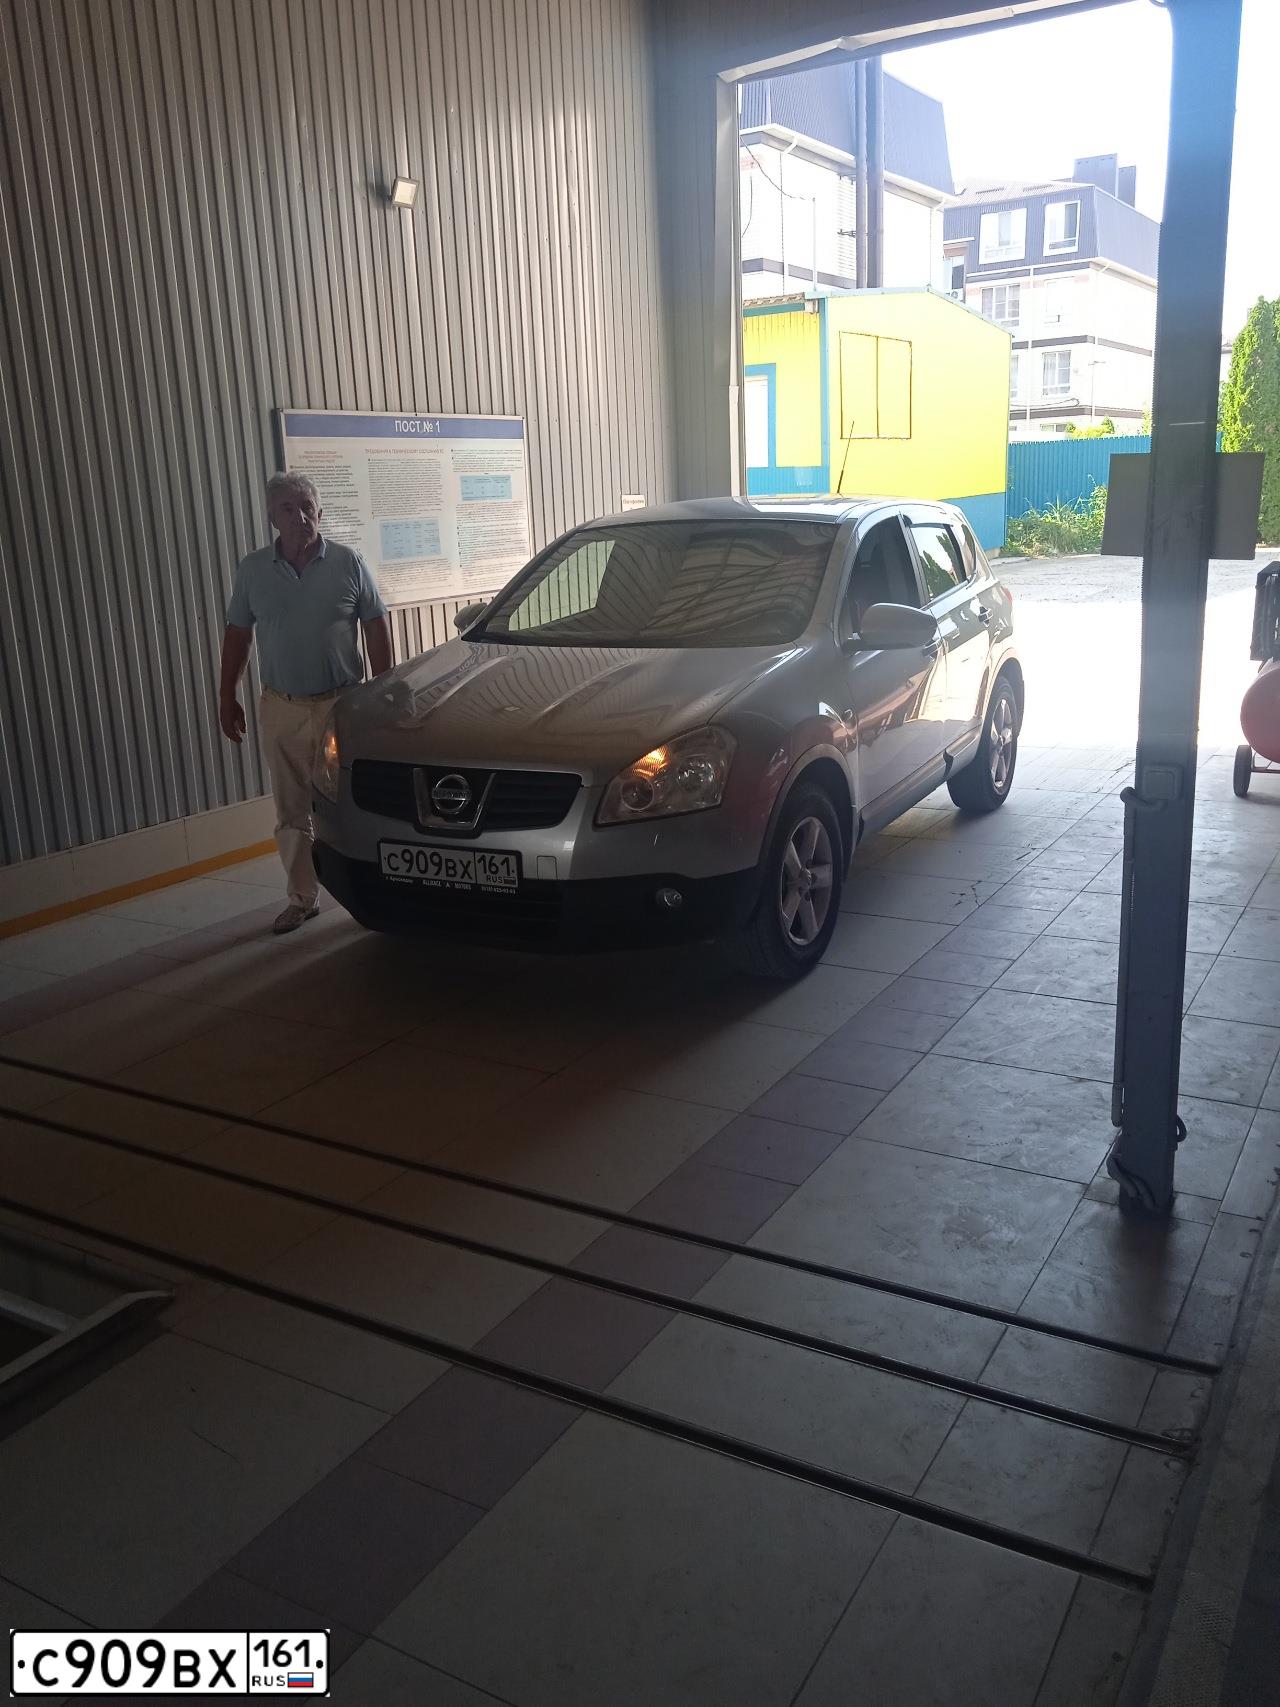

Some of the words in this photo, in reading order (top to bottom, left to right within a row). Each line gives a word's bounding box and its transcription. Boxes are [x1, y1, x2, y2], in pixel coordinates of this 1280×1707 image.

[395, 420, 420, 433] ПОСТ
[423, 421, 434, 433] №
[435, 421, 441, 433] 1
[387, 848, 473, 880] С909ВХ
[477, 854, 511, 876] 161
[486, 875, 503, 884] RUS
